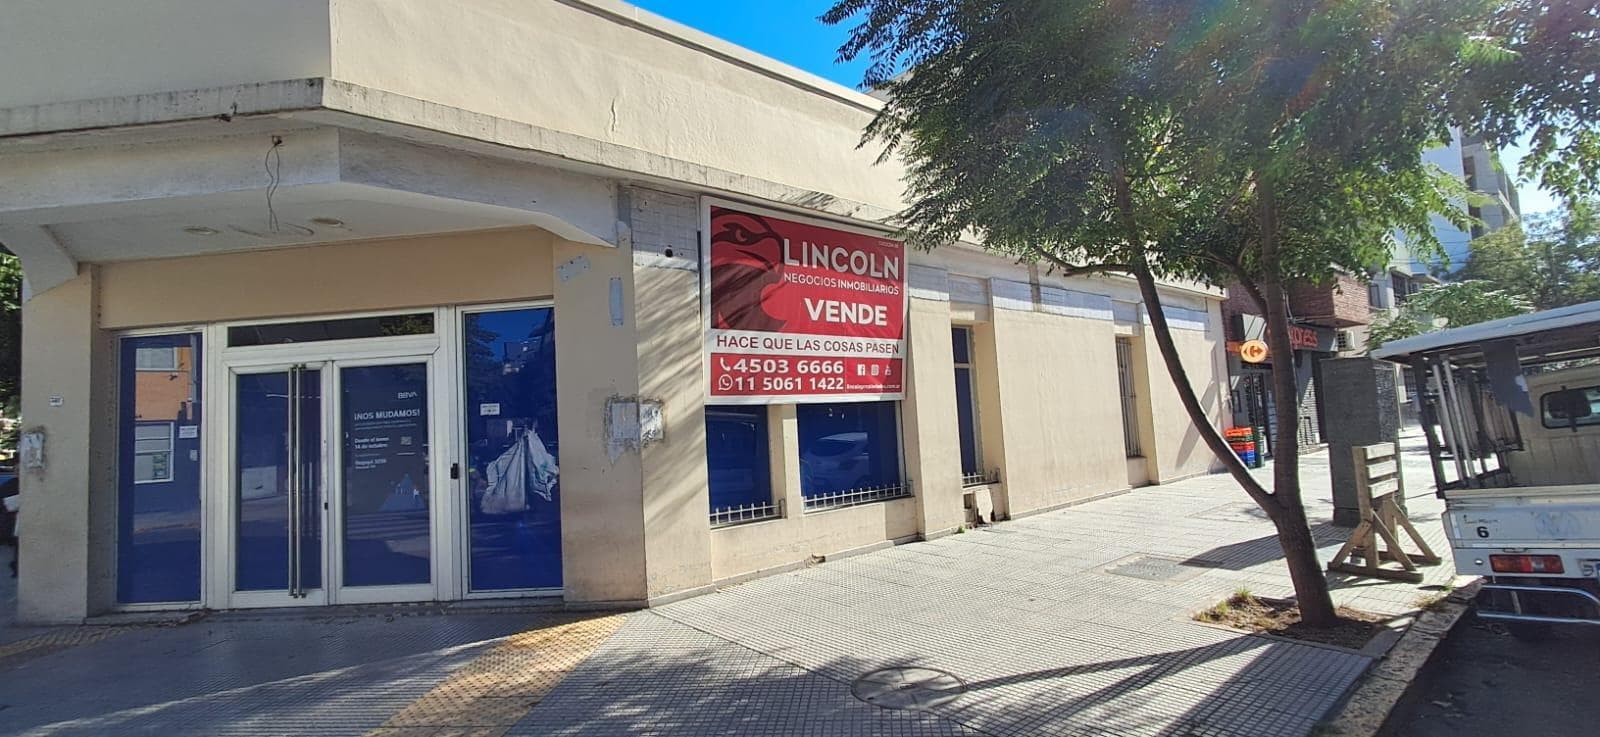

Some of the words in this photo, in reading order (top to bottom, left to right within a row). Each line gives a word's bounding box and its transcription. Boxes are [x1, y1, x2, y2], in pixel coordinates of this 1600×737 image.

[784, 238, 899, 280] LINCOLN
[783, 272, 837, 288] NEGOCIOS
[837, 279, 900, 296] INMOBILIARIOS
[803, 298, 888, 326] VENDE
[716, 335, 759, 349] HACE
[762, 337, 793, 350] QUE
[796, 338, 821, 351] LAS
[823, 340, 864, 353] COSAS
[865, 342, 899, 354] PASEN
[733, 359, 789, 374] 4503
[796, 360, 844, 374] 6666
[734, 376, 755, 391] 11
[762, 377, 802, 391] 5061
[809, 377, 844, 391] 1422
[376, 408, 420, 418] MUDAMOS!
[1477, 526, 1490, 538] 6
